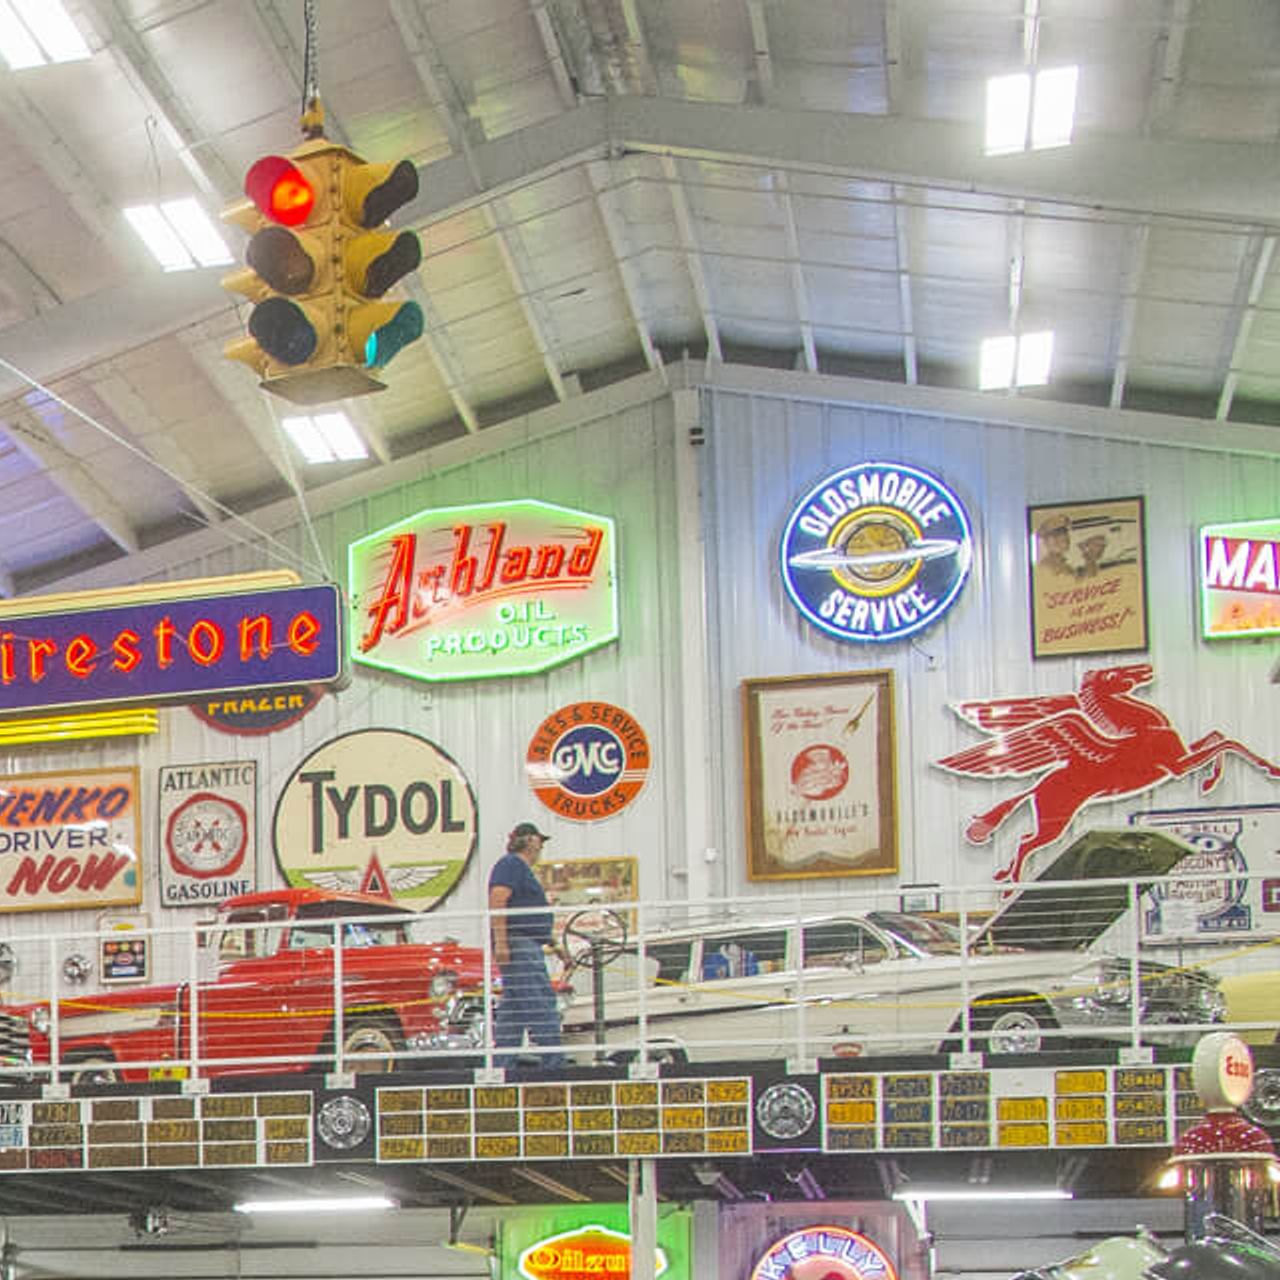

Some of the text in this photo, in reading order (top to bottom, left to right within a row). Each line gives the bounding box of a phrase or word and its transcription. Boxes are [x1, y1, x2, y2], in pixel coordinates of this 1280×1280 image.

[799, 471, 952, 537] OLDSMOBILE
[358, 521, 605, 655] Ashland
[496, 602, 557, 625] OIL
[818, 583, 939, 633] SERVICE
[425, 625, 589, 661] PRODUCTS
[590, 704, 647, 759] SERVICE
[556, 742, 621, 777] GMC
[164, 767, 254, 792] ATLANTIC
[299, 771, 466, 855] TYDOL
[552, 789, 627, 816] TRUCKS
[7, 853, 131, 896] NOW
[166, 881, 253, 900] GASOLINE
[527, 1246, 626, 1272] Oilzu
